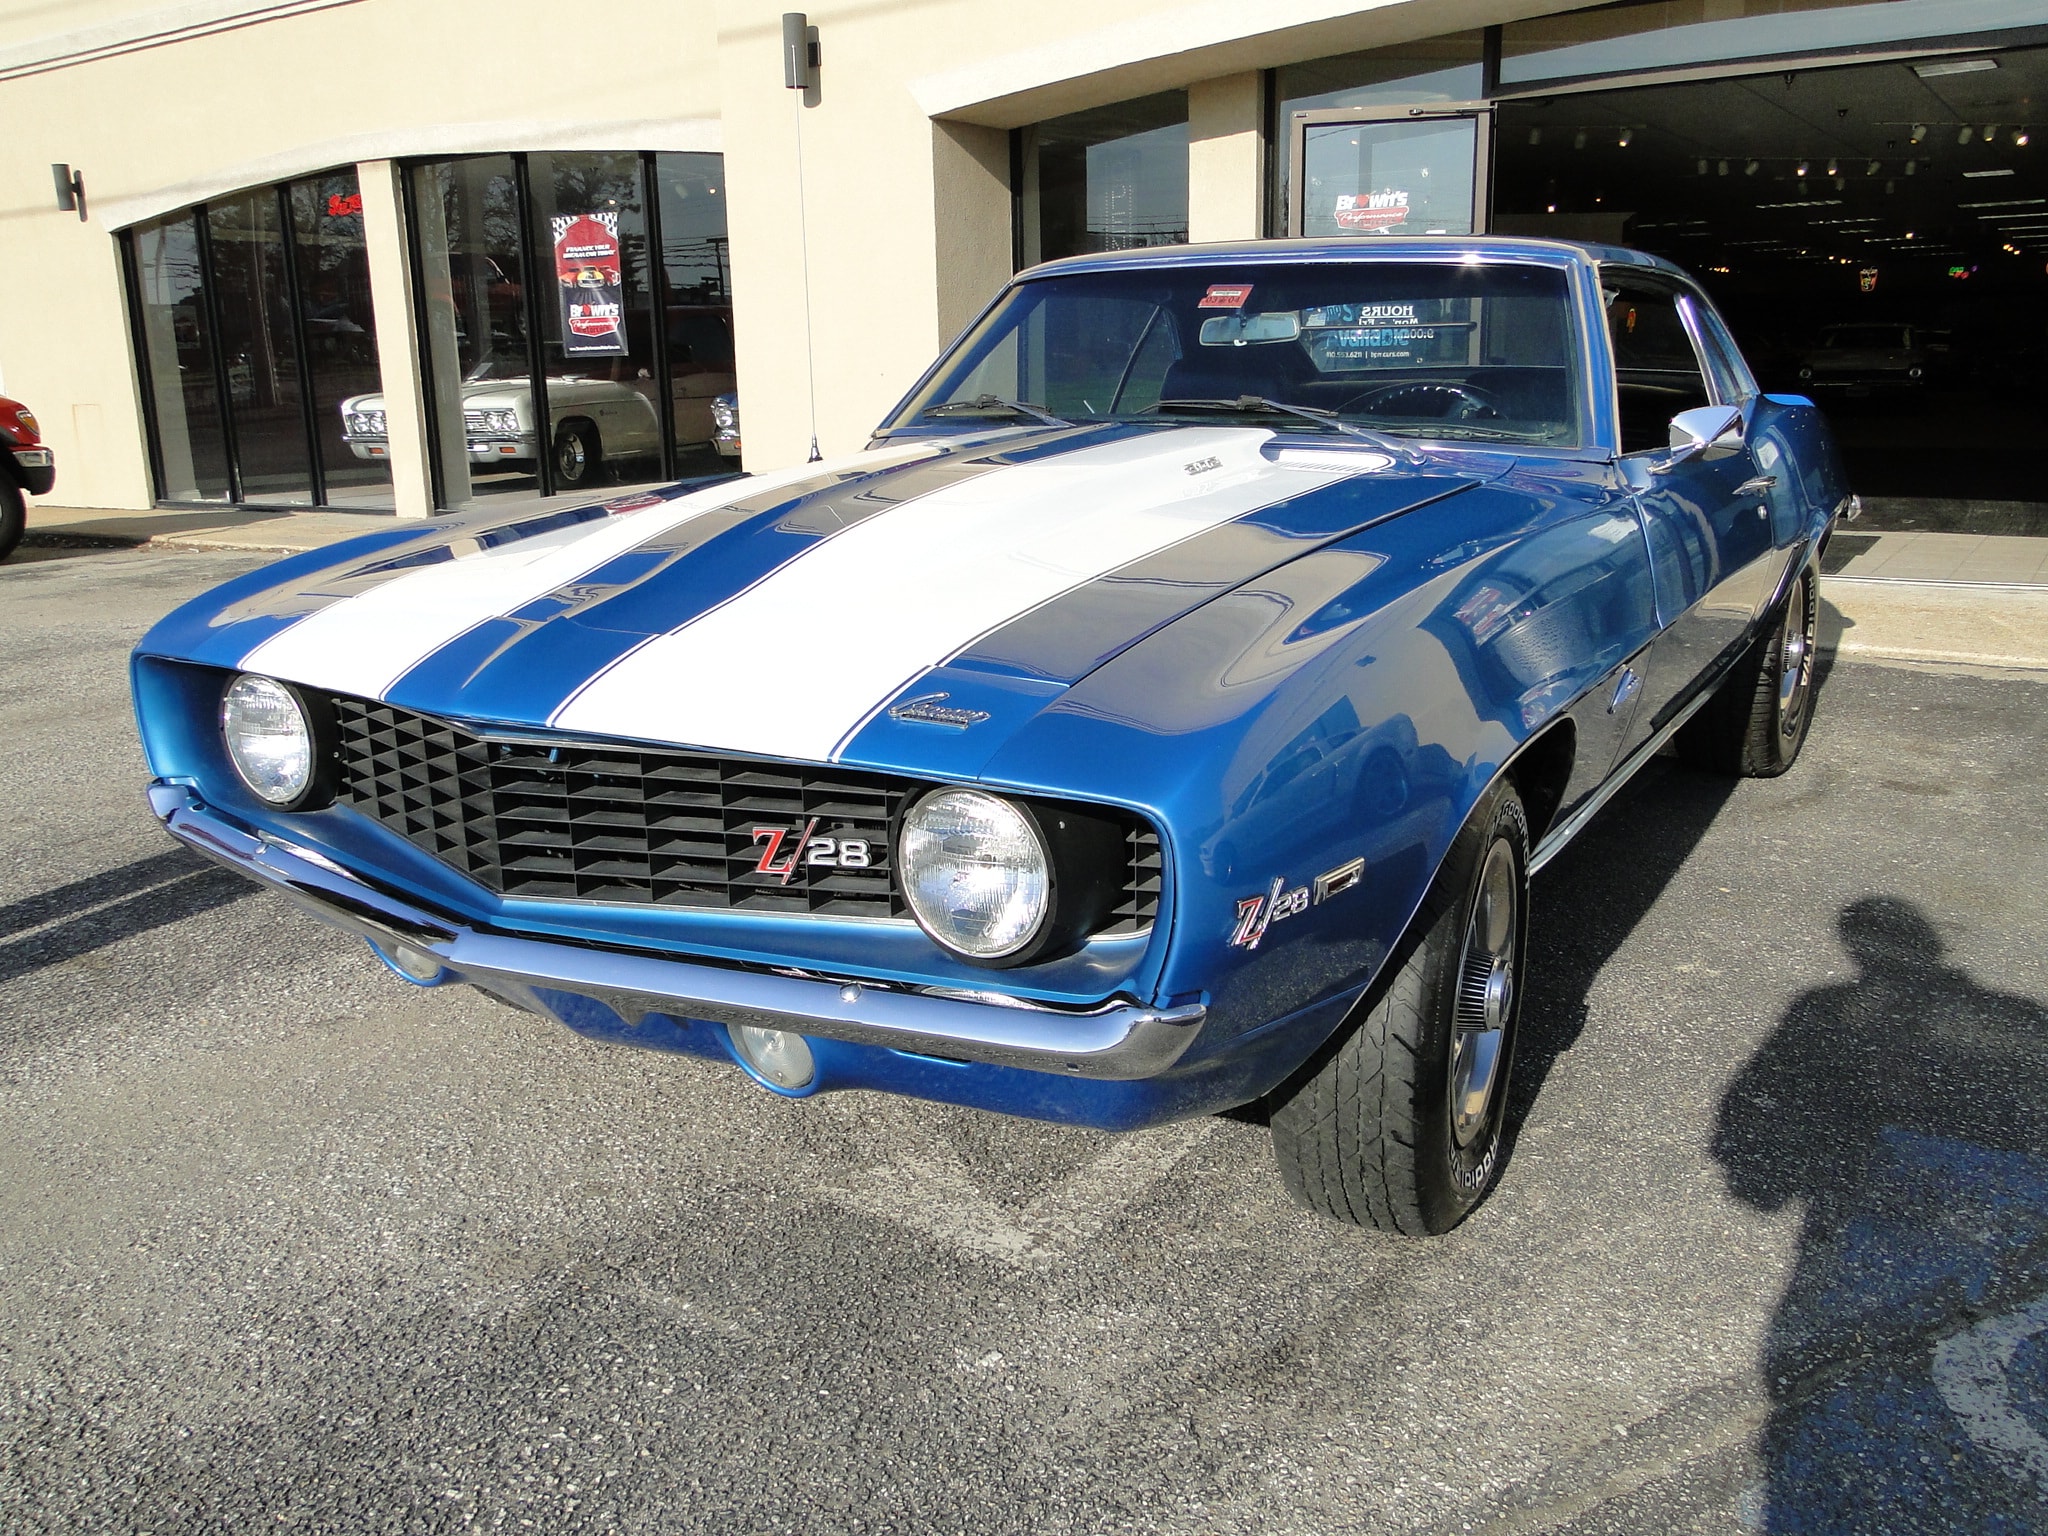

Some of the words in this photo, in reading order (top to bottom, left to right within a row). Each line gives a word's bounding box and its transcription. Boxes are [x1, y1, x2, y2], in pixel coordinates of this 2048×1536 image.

[1800, 653, 1811, 686] T/A
[752, 816, 872, 886] Z/28
[1227, 876, 1309, 950] Z/28
